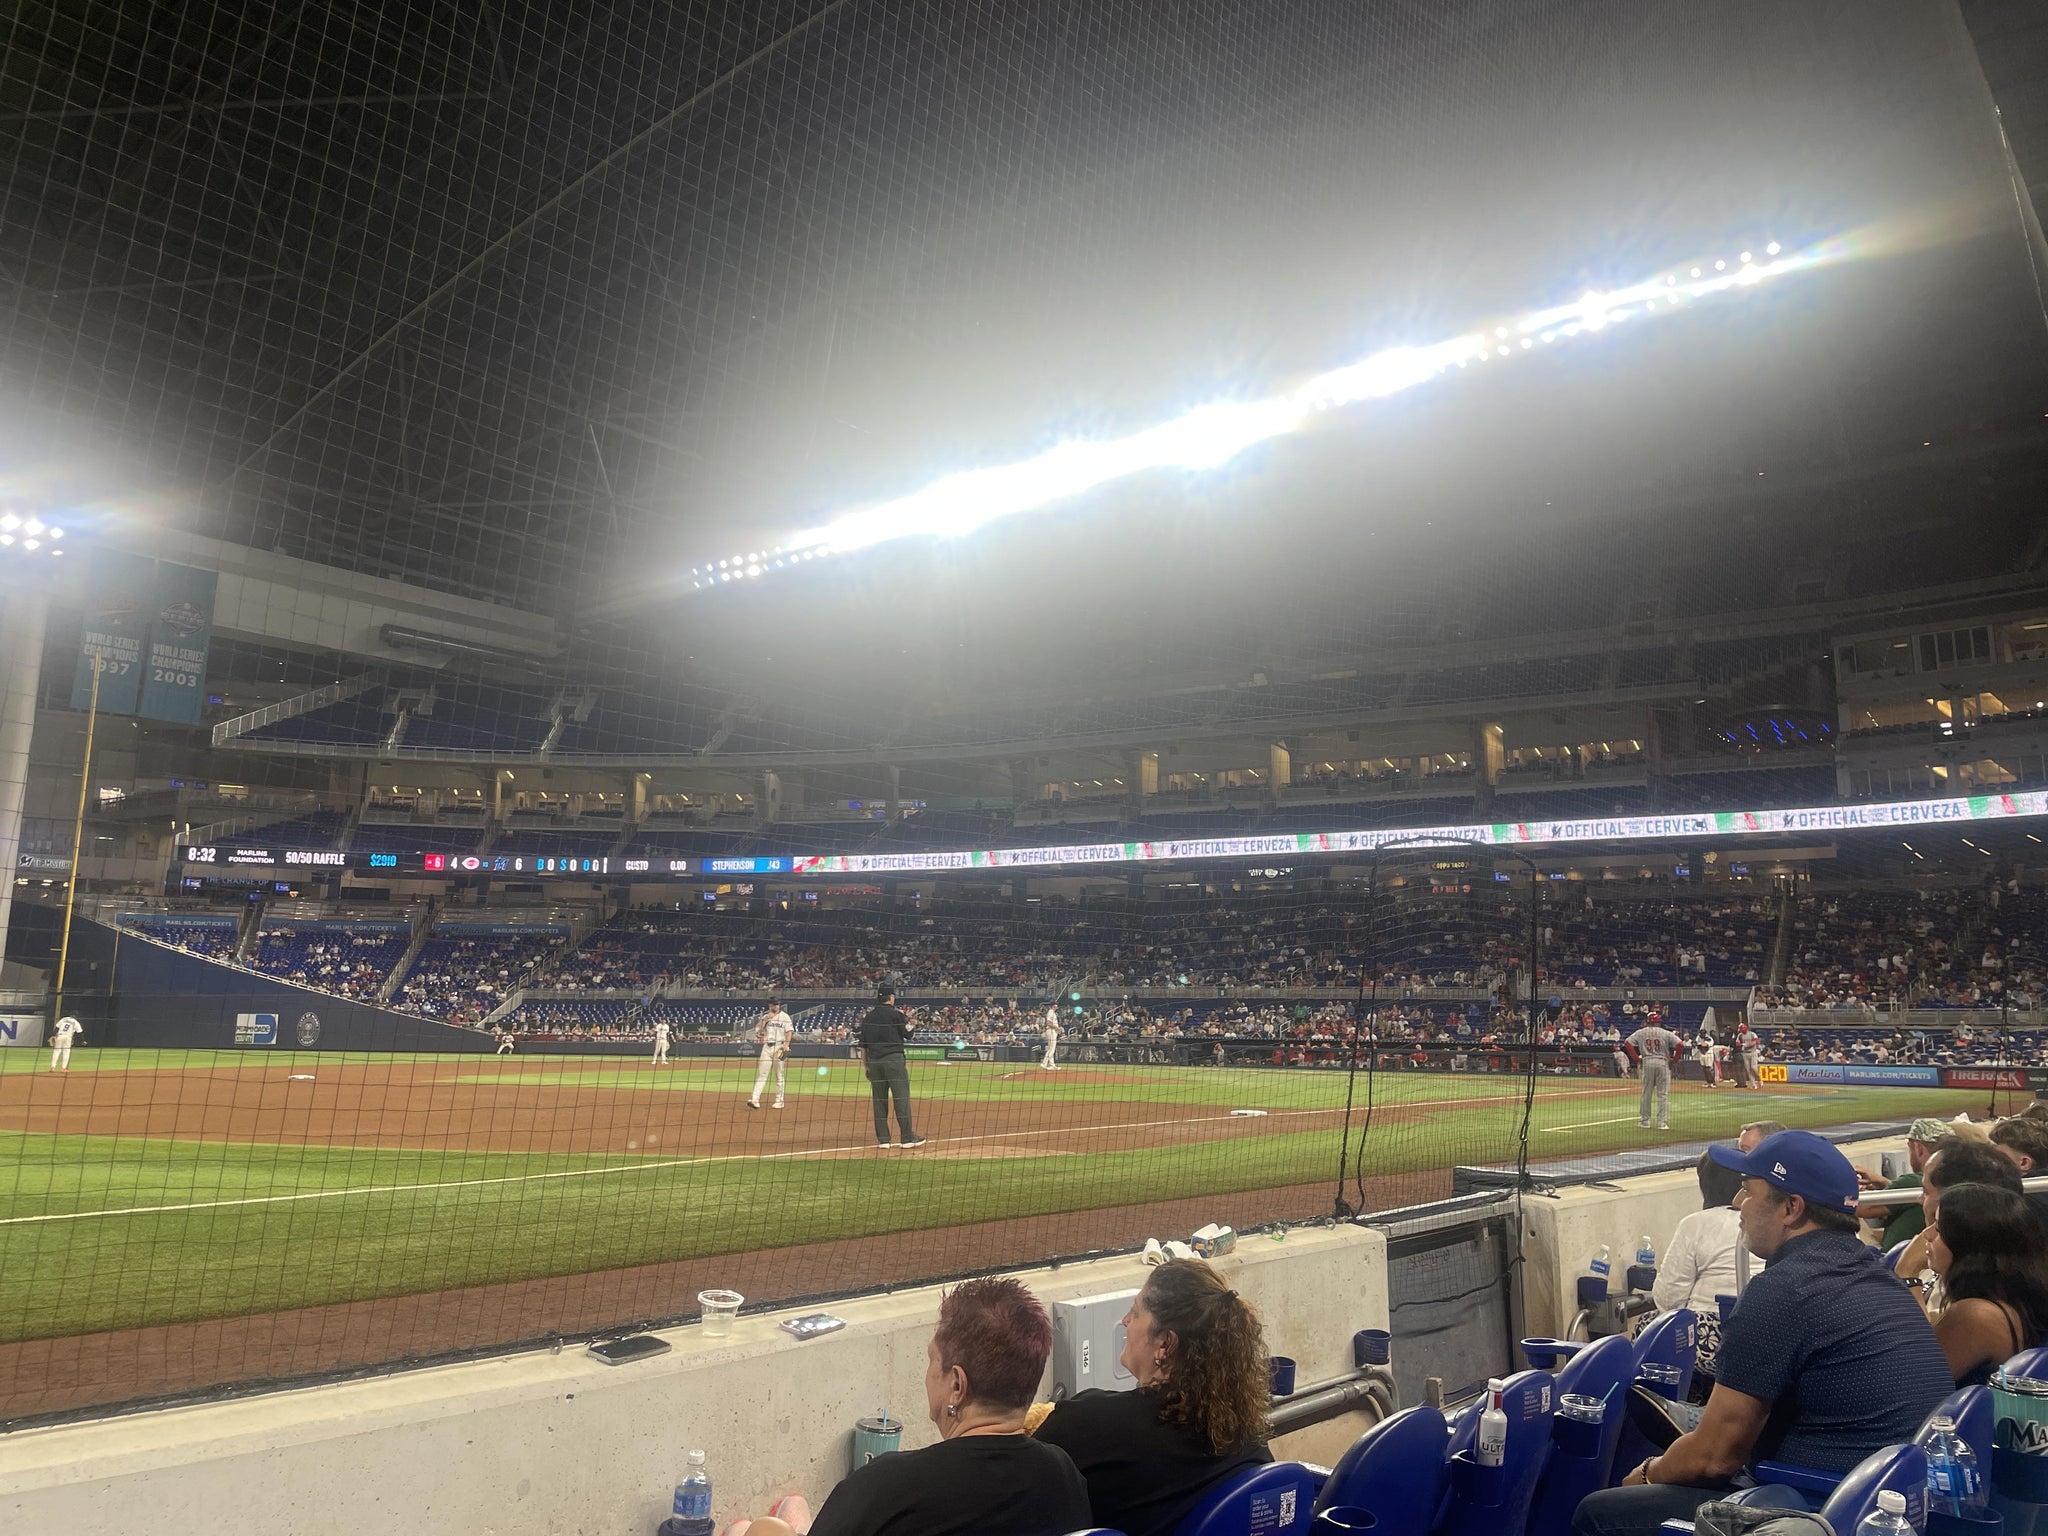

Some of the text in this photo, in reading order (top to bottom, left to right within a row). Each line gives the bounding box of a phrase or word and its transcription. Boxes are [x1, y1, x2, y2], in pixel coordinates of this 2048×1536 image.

[86, 632, 140, 650] WORLD SERIES
[153, 643, 205, 662] WORLD SERIES
[152, 655, 203, 673] CHAMPIONS
[154, 670, 197, 687] 2003
[1799, 810, 1867, 826] OFFICIAL
[1891, 803, 1961, 821] CERVEZA
[1566, 822, 1625, 837] OFFICIAL
[188, 847, 216, 862] 8:32
[1181, 839, 1292, 856] OFFICIAL CERVEZA
[228, 856, 274, 864] FOUNDATION
[285, 851, 345, 865] 50/50 RAFFLE
[871, 855, 967, 869] OFFICIAL CERVEZA
[1021, 848, 1120, 863] OFFICIAL CERVEZA
[450, 857, 458, 869] 4
[515, 858, 523, 870] 6
[712, 861, 754, 871] STEPHENSON
[1797, 1068, 1841, 1079] Marlins
[1849, 1071, 1931, 1080] MARLINS.COM/TICKETS
